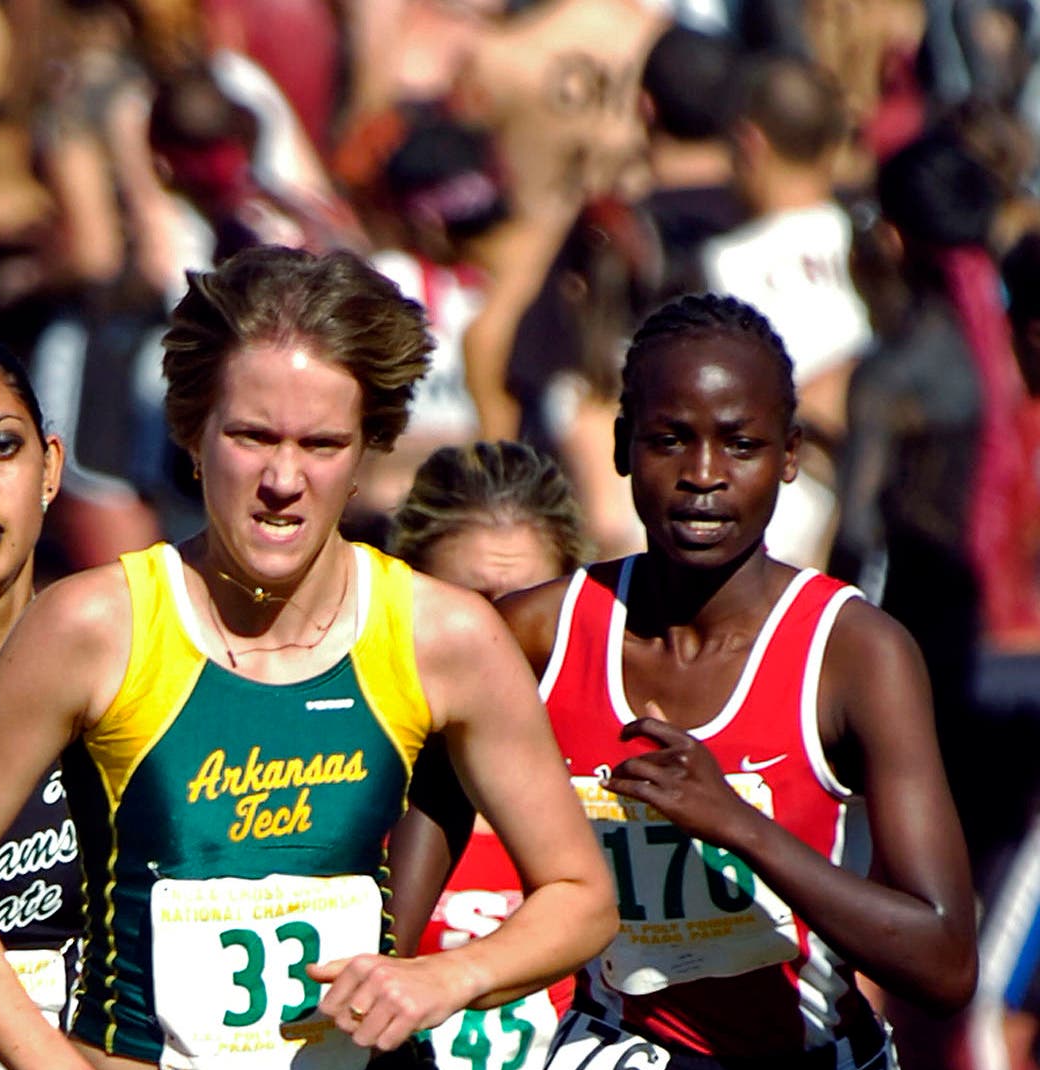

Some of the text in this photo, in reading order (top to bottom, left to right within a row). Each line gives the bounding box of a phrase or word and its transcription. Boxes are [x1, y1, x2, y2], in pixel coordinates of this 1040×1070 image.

[187, 745, 368, 804] Arkansas
[228, 787, 312, 842] Tech
[605, 824, 756, 914] 176
[161, 904, 242, 922] NATIONAL
[219, 920, 321, 1027] 33
